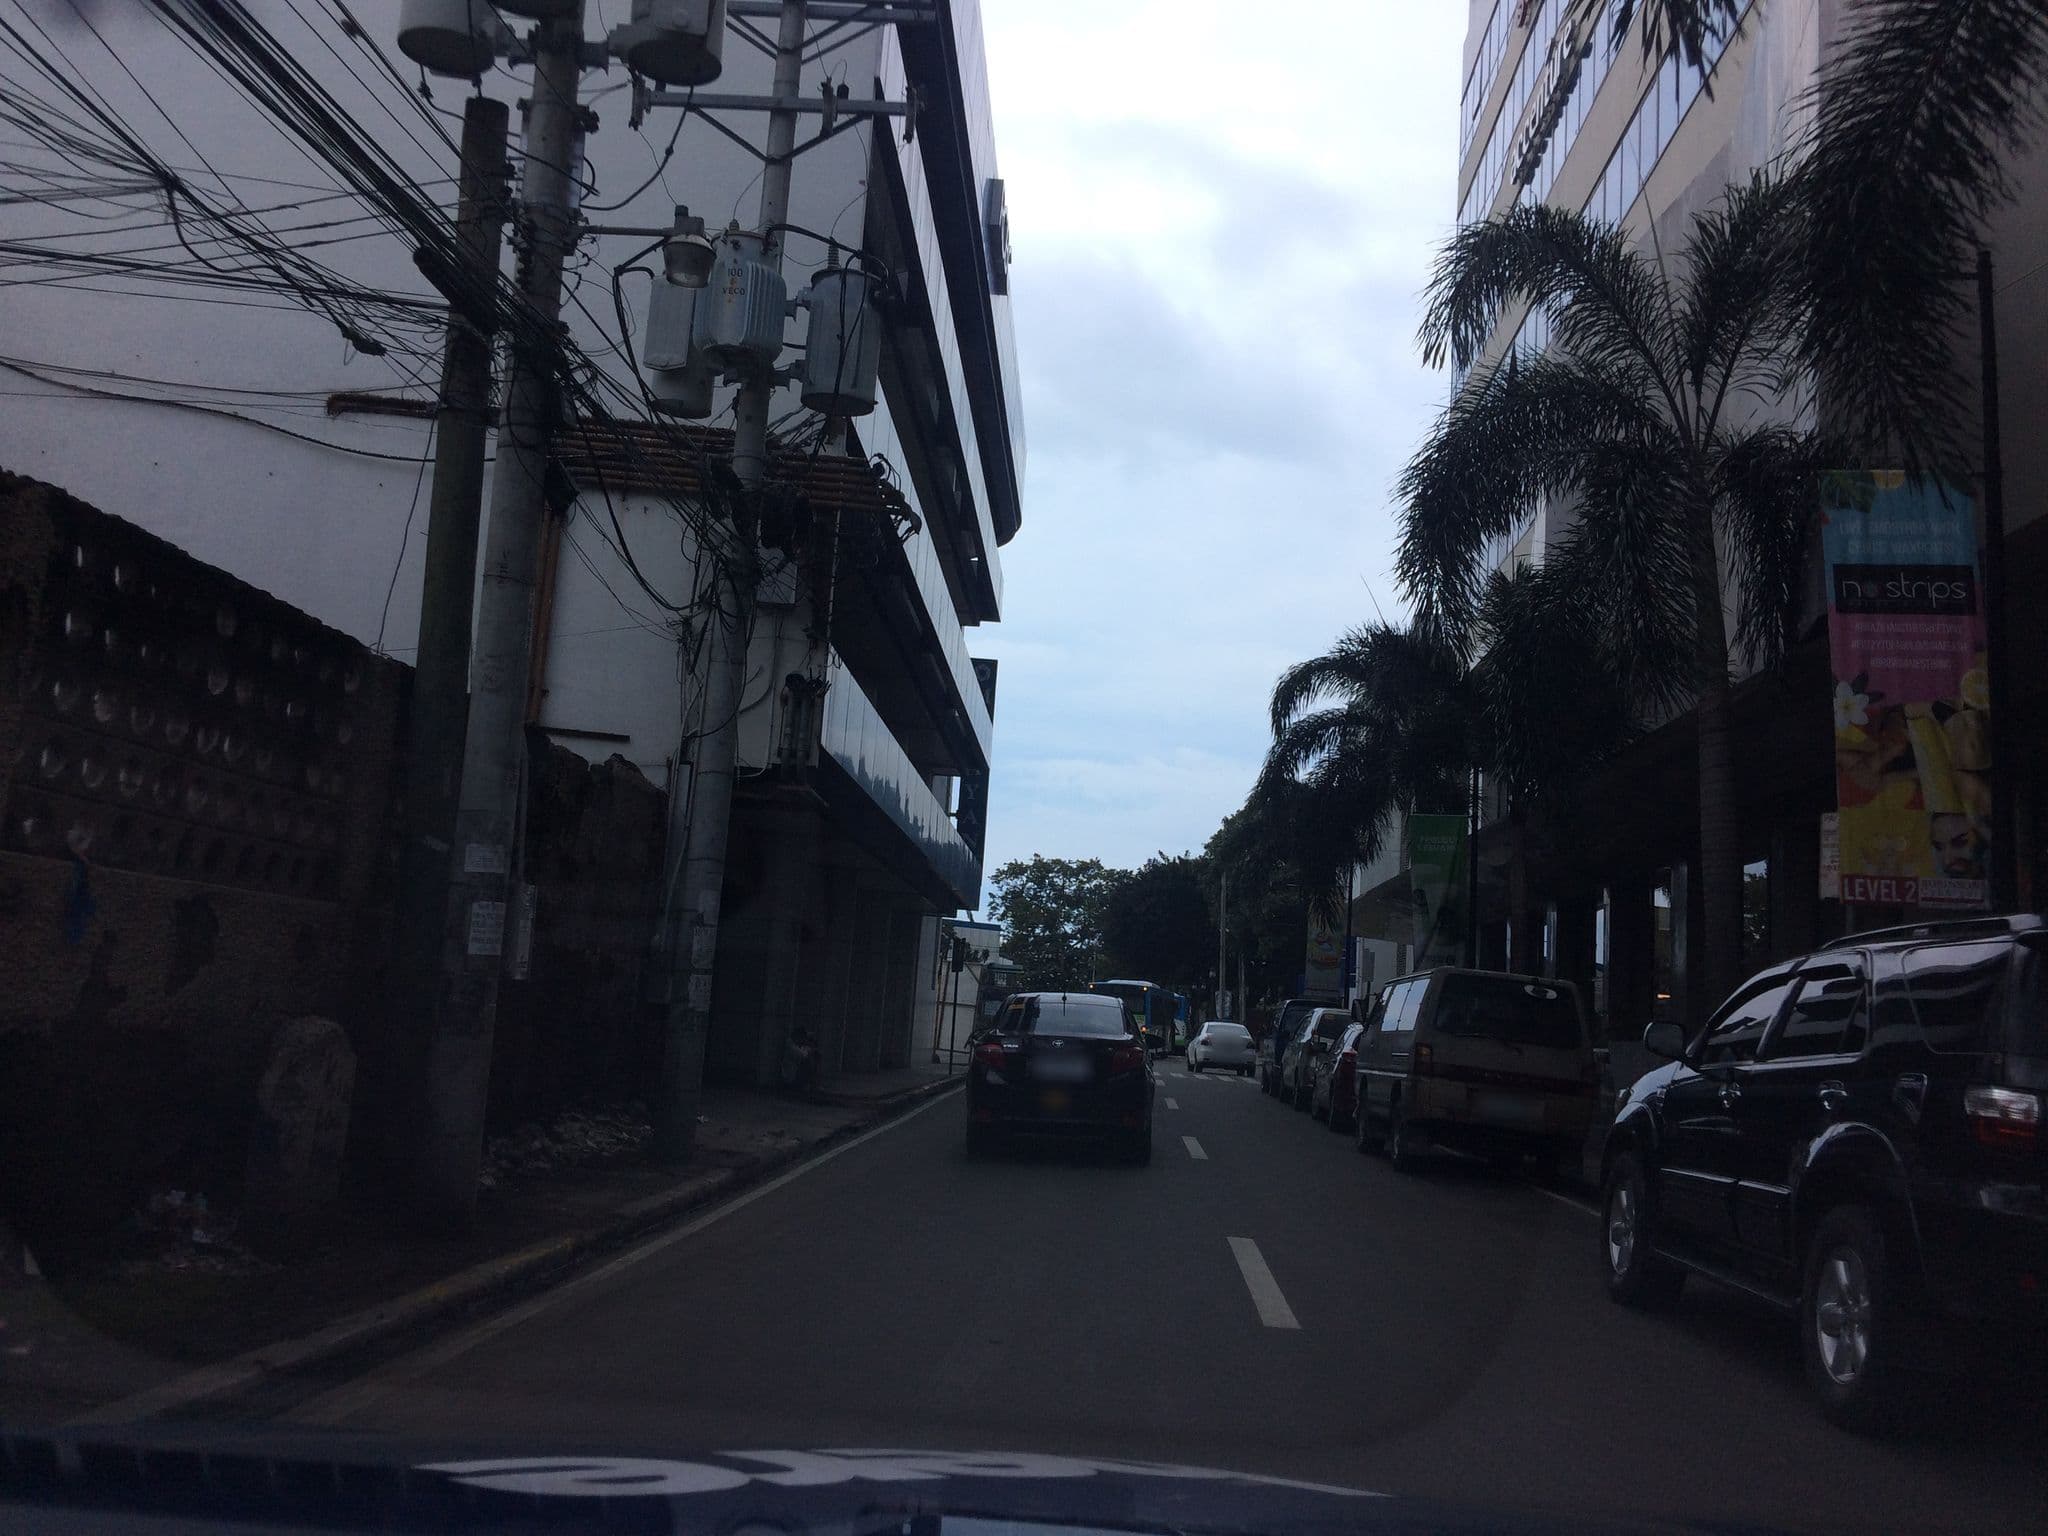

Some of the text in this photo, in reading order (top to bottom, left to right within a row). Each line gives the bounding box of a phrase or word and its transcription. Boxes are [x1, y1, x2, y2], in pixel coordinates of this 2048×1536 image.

[1510, 19, 1573, 185] accenture
[728, 268, 743, 277] 100
[722, 287, 745, 295] VECO
[1844, 878, 1902, 901] LEVEL
[1905, 882, 1917, 903] 2
